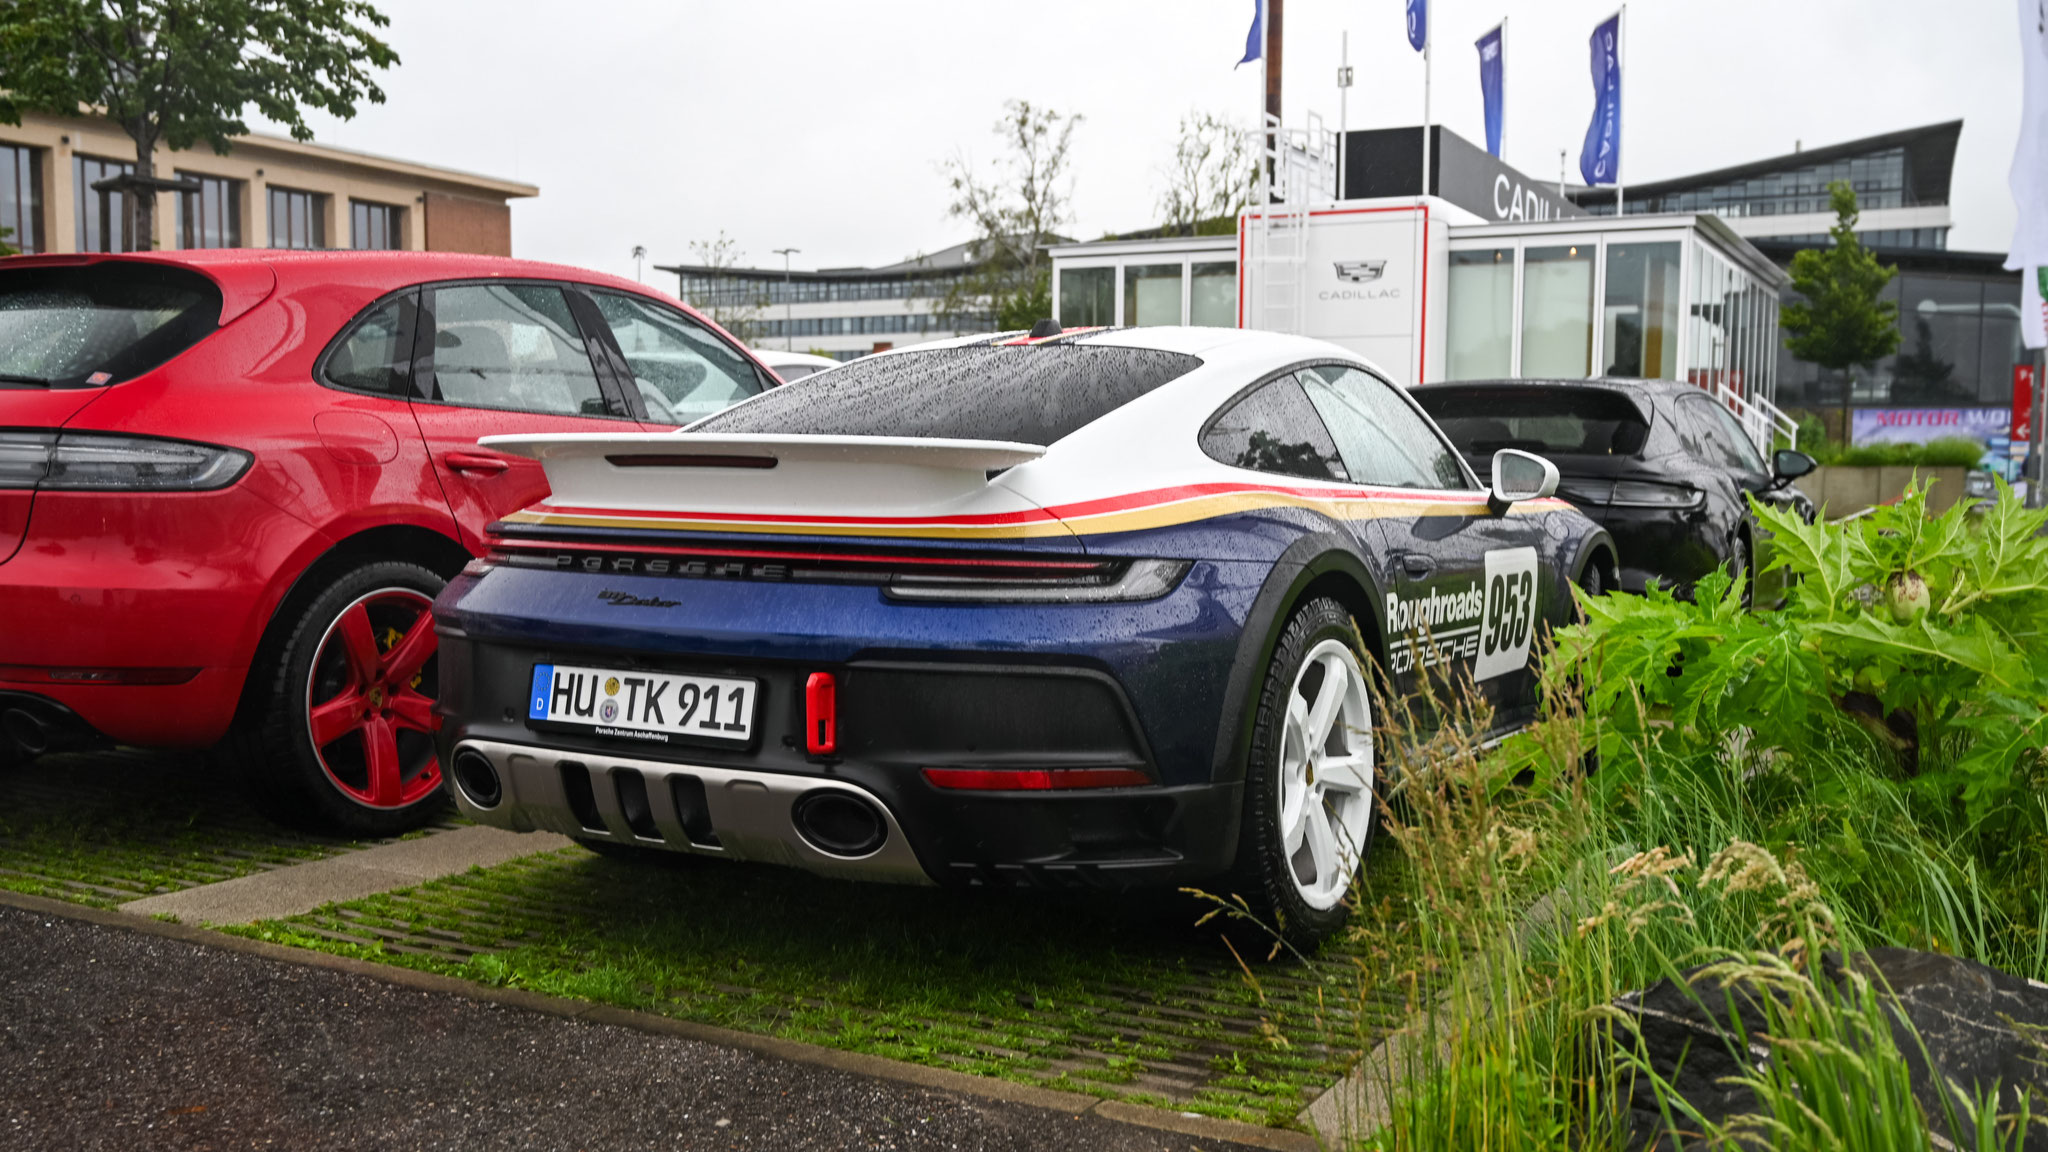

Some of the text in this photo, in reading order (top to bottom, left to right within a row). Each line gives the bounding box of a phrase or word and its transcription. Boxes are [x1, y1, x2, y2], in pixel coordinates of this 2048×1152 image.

[1318, 288, 1400, 301] CADILLAC
[1876, 410, 1959, 427] MOTOR
[557, 555, 786, 578] PORSCHE
[1386, 570, 1533, 657] Roughroads 953
[536, 697, 544, 711] D
[551, 672, 747, 732] HU TK 911
[595, 726, 614, 736] Porsche
[614, 728, 634, 738] Zentrum
